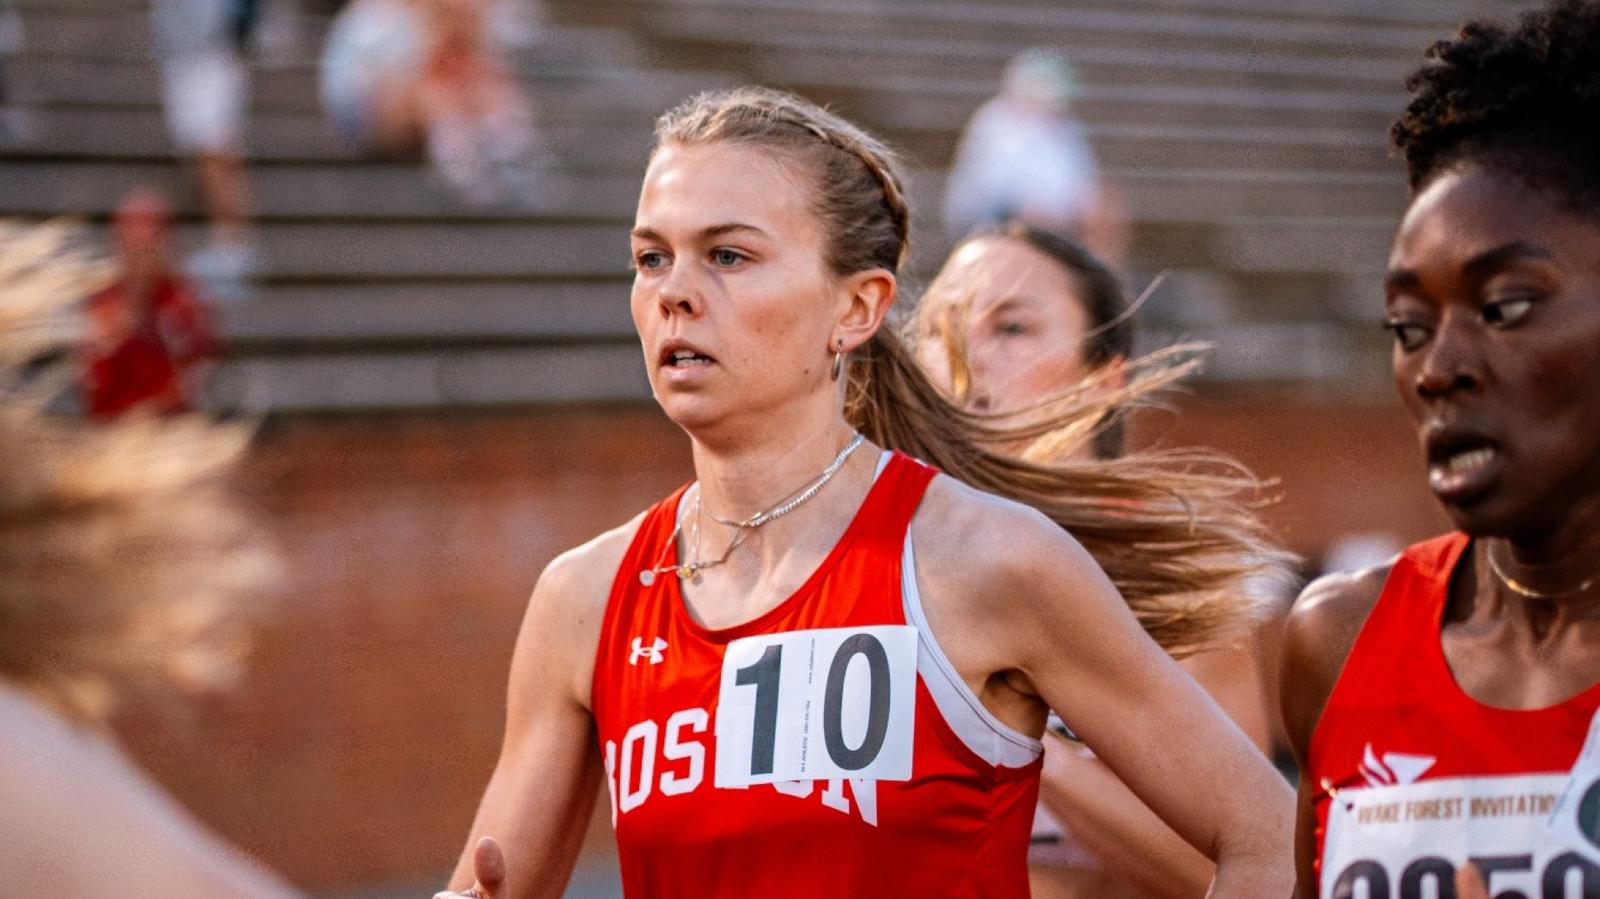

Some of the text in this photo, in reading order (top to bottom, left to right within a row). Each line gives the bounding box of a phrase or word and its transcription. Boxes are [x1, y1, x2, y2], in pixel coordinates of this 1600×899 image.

[735, 633, 891, 776] 10
[1358, 803, 1399, 824] WAKE
[1404, 797, 1463, 822] FOREST
